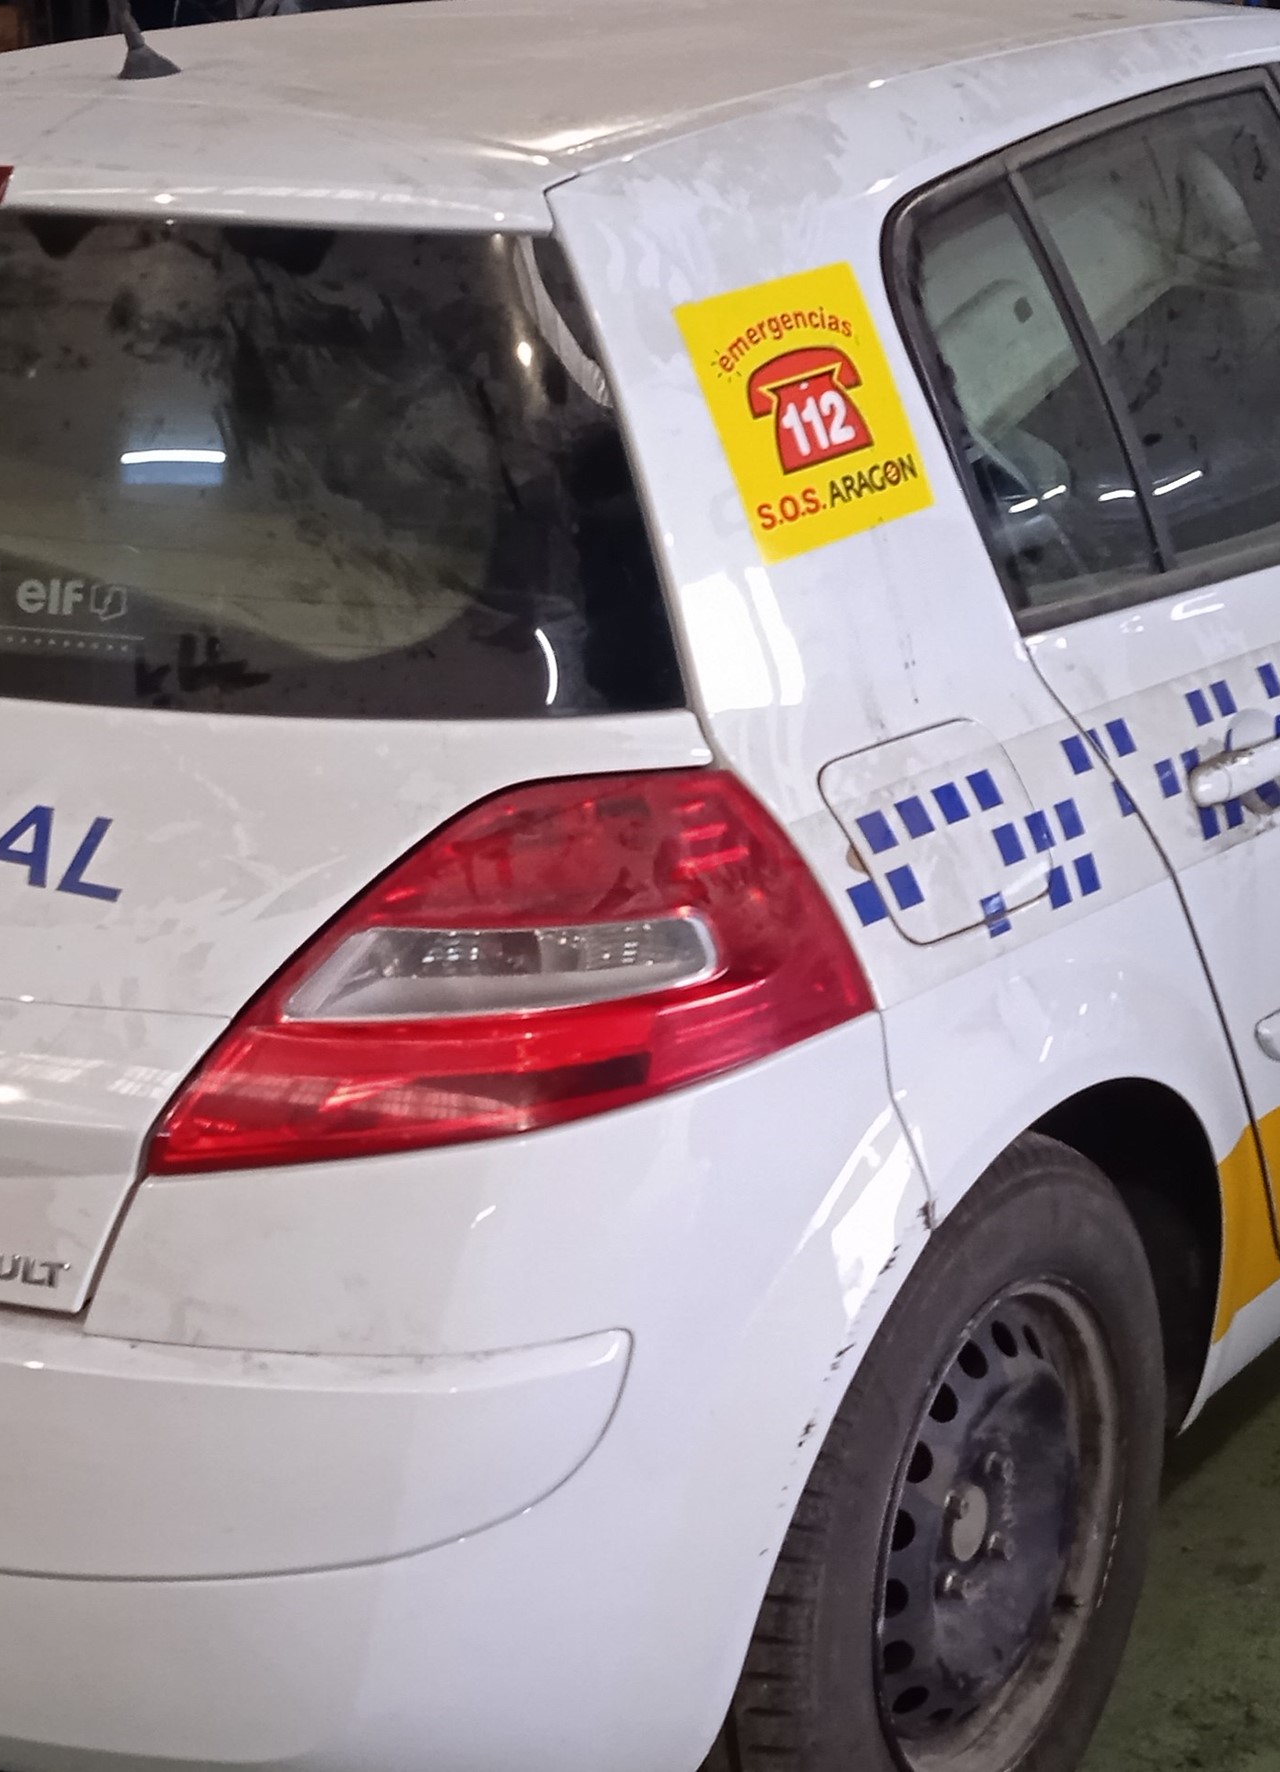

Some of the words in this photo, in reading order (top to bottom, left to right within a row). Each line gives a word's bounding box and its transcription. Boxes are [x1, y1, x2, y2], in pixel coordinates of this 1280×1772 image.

[718, 306, 853, 374] emergencias
[781, 389, 857, 457] 112
[757, 487, 828, 530] S.O.S.
[16, 578, 85, 616] elf
